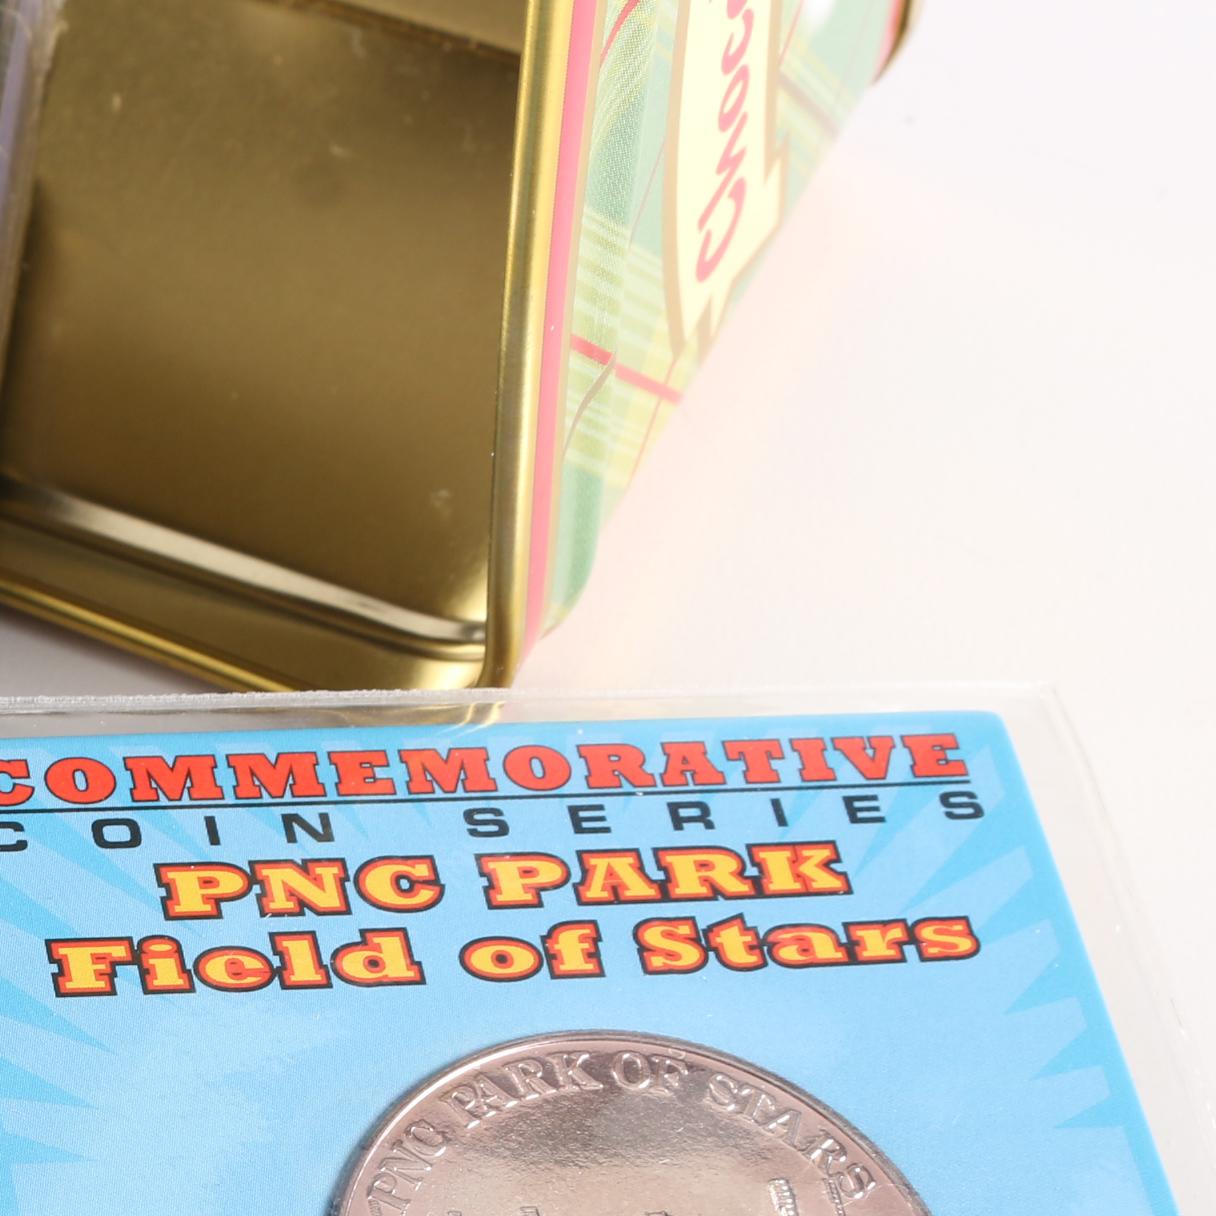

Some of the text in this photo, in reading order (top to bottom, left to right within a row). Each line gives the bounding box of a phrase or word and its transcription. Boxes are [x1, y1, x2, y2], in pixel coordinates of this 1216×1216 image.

[695, 0, 752, 283] Choc
[464, 790, 985, 838] SERIES
[153, 840, 854, 921] PNC PARK
[45, 912, 981, 998] Field of Stars
[368, 1053, 876, 1215] PNC PARK OF STARS
